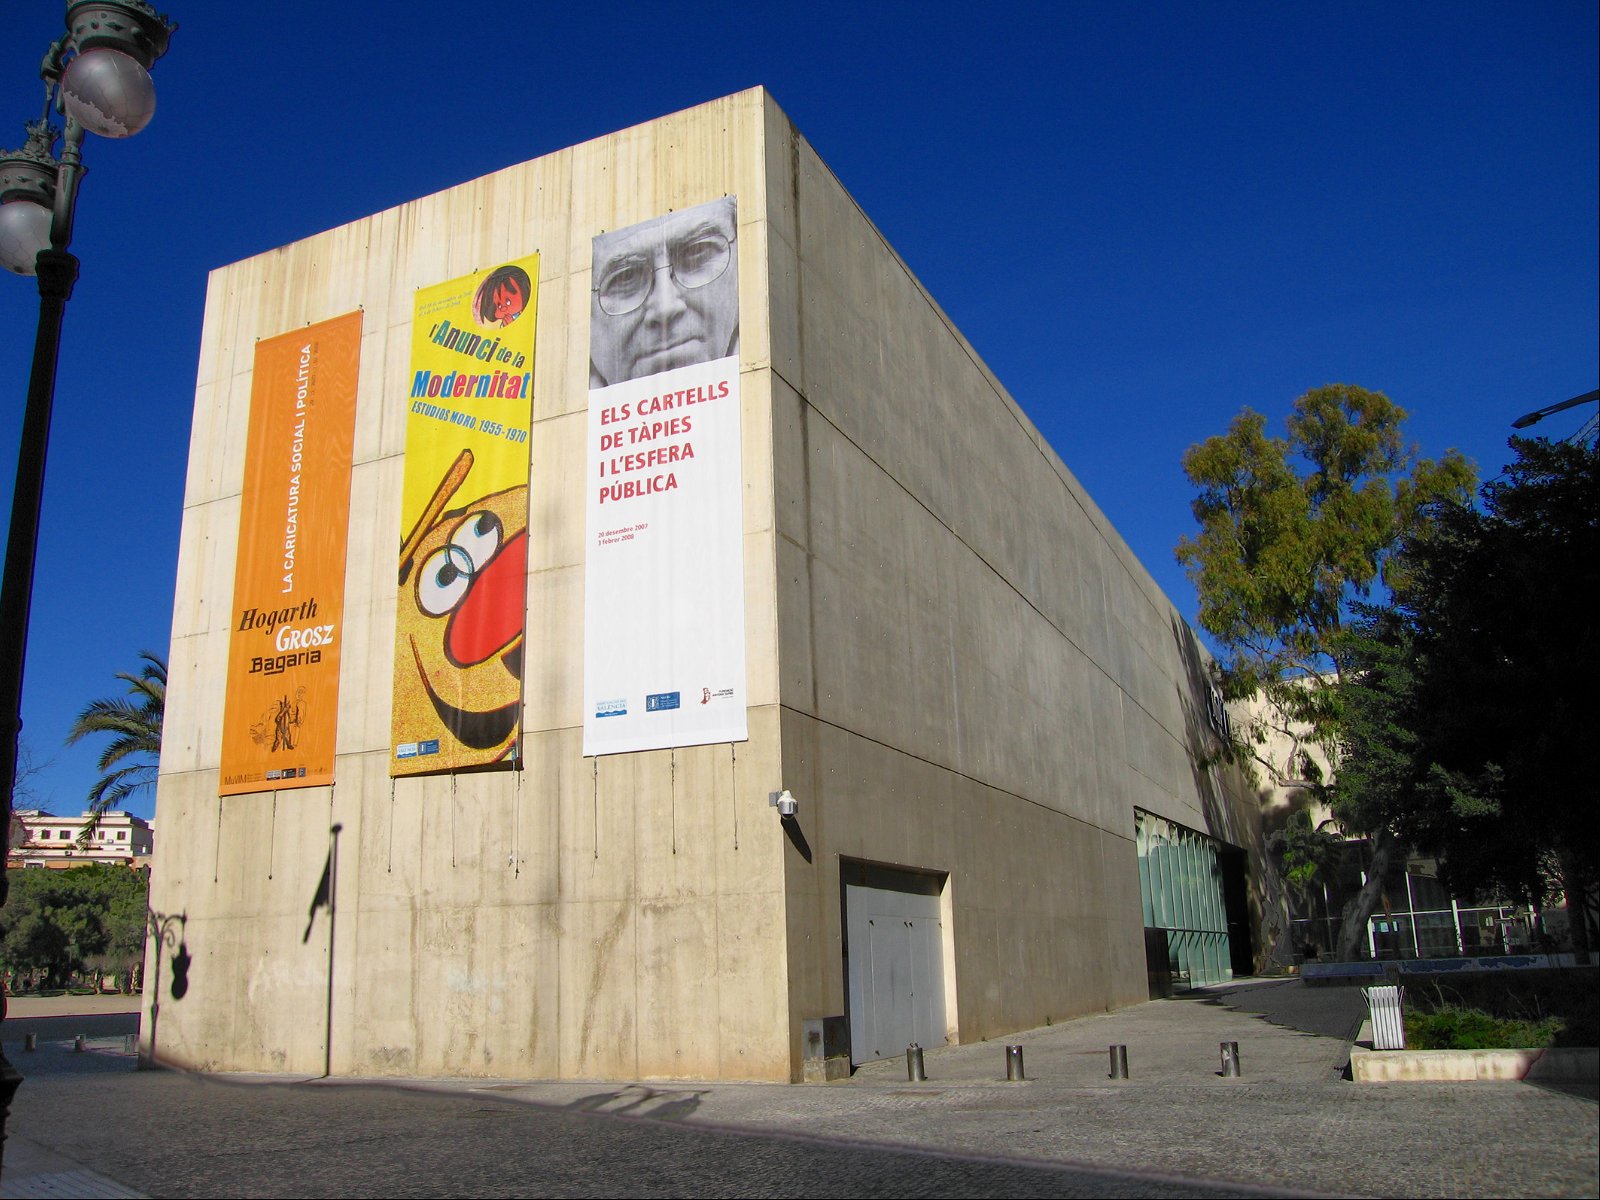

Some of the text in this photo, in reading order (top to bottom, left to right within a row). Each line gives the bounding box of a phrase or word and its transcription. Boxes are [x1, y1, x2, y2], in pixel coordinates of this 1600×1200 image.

[429, 319, 526, 368] l'Anunci de la
[296, 343, 312, 410] POLÍTICA
[410, 370, 530, 399] Modernitat
[601, 380, 729, 425] ELS CARTELLS
[411, 400, 527, 444] ESTUDIOS MORO, 1955-1970
[600, 415, 691, 451] DE TÀPIES
[291, 419, 305, 472] SOCIAL
[600, 442, 694, 478] I L'ESFERA
[599, 472, 677, 504] PÚBLICA
[283, 474, 300, 571] CARICATURA
[602, 537, 620, 545] febrer
[621, 533, 634, 541] 2008
[605, 526, 633, 537] desembre
[635, 523, 648, 531] 2007
[282, 573, 293, 593] LA
[237, 597, 318, 635] Hogarth
[275, 624, 335, 652] GROSZ
[249, 649, 322, 675] Bagaria
